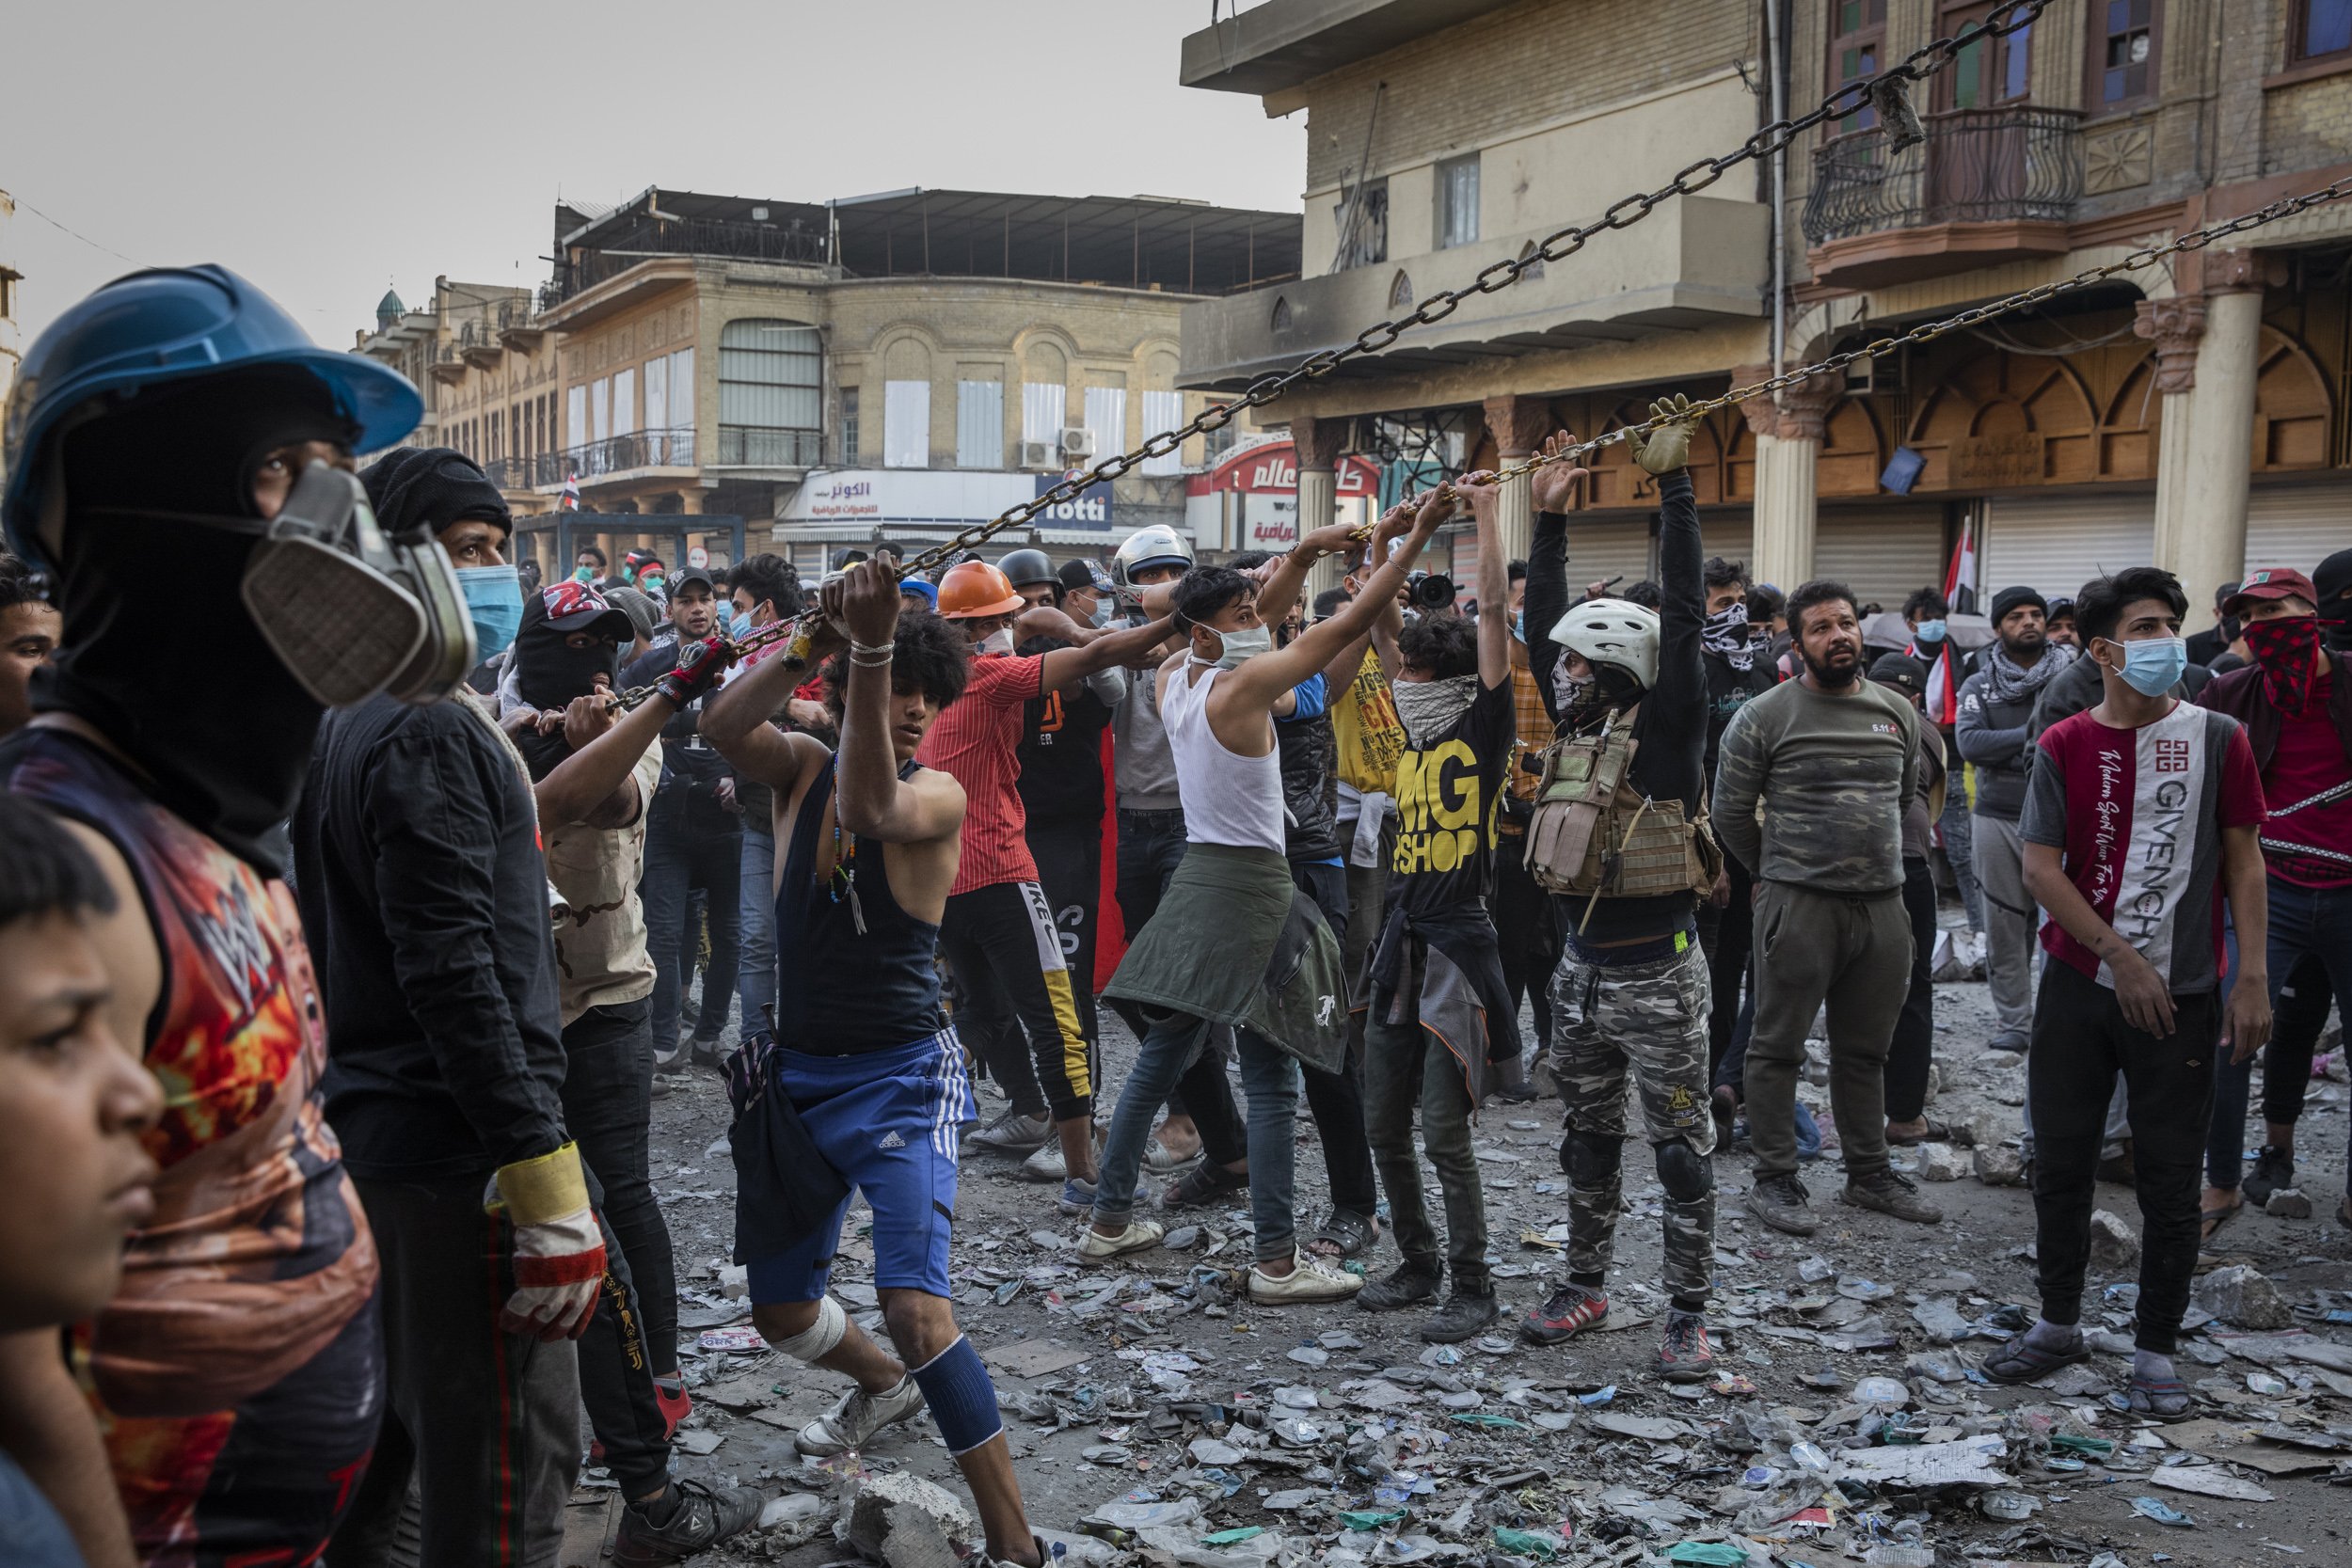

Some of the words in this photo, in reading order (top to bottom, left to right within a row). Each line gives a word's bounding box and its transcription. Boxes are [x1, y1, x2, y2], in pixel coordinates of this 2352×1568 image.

[1254, 521, 1295, 542] رياضية
[1393, 829, 1478, 875] SHOP
[1025, 882, 1051, 922] IKE
[879, 1138, 906, 1148] adidas
